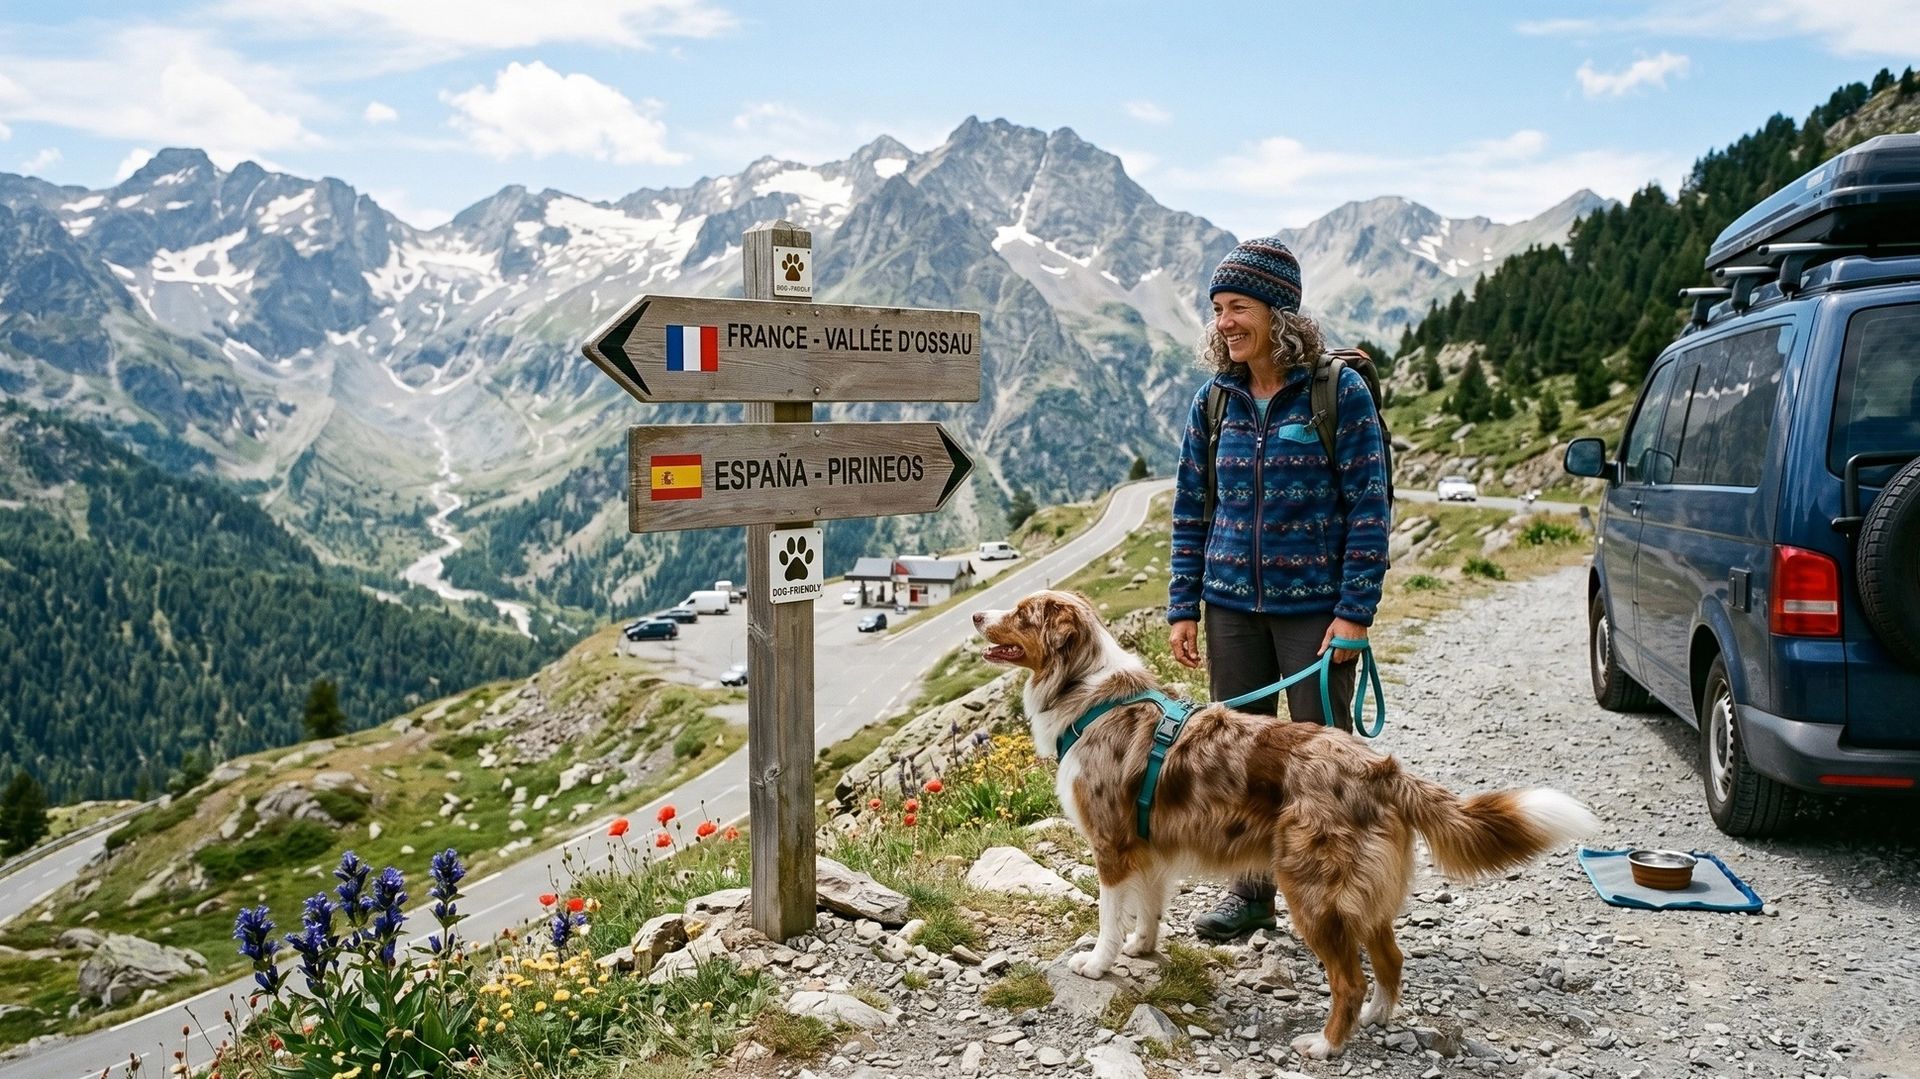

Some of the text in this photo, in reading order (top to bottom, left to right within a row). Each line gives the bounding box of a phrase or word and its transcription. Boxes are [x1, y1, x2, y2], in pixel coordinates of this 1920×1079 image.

[727, 322, 808, 350] FRANCE
[825, 322, 893, 352] VALLÉE
[898, 330, 972, 355] D'OSSAU
[714, 452, 808, 491] ESPAÑA
[828, 454, 924, 485] PIRINEOS
[772, 583, 822, 597] DOG-FRIENDLY
